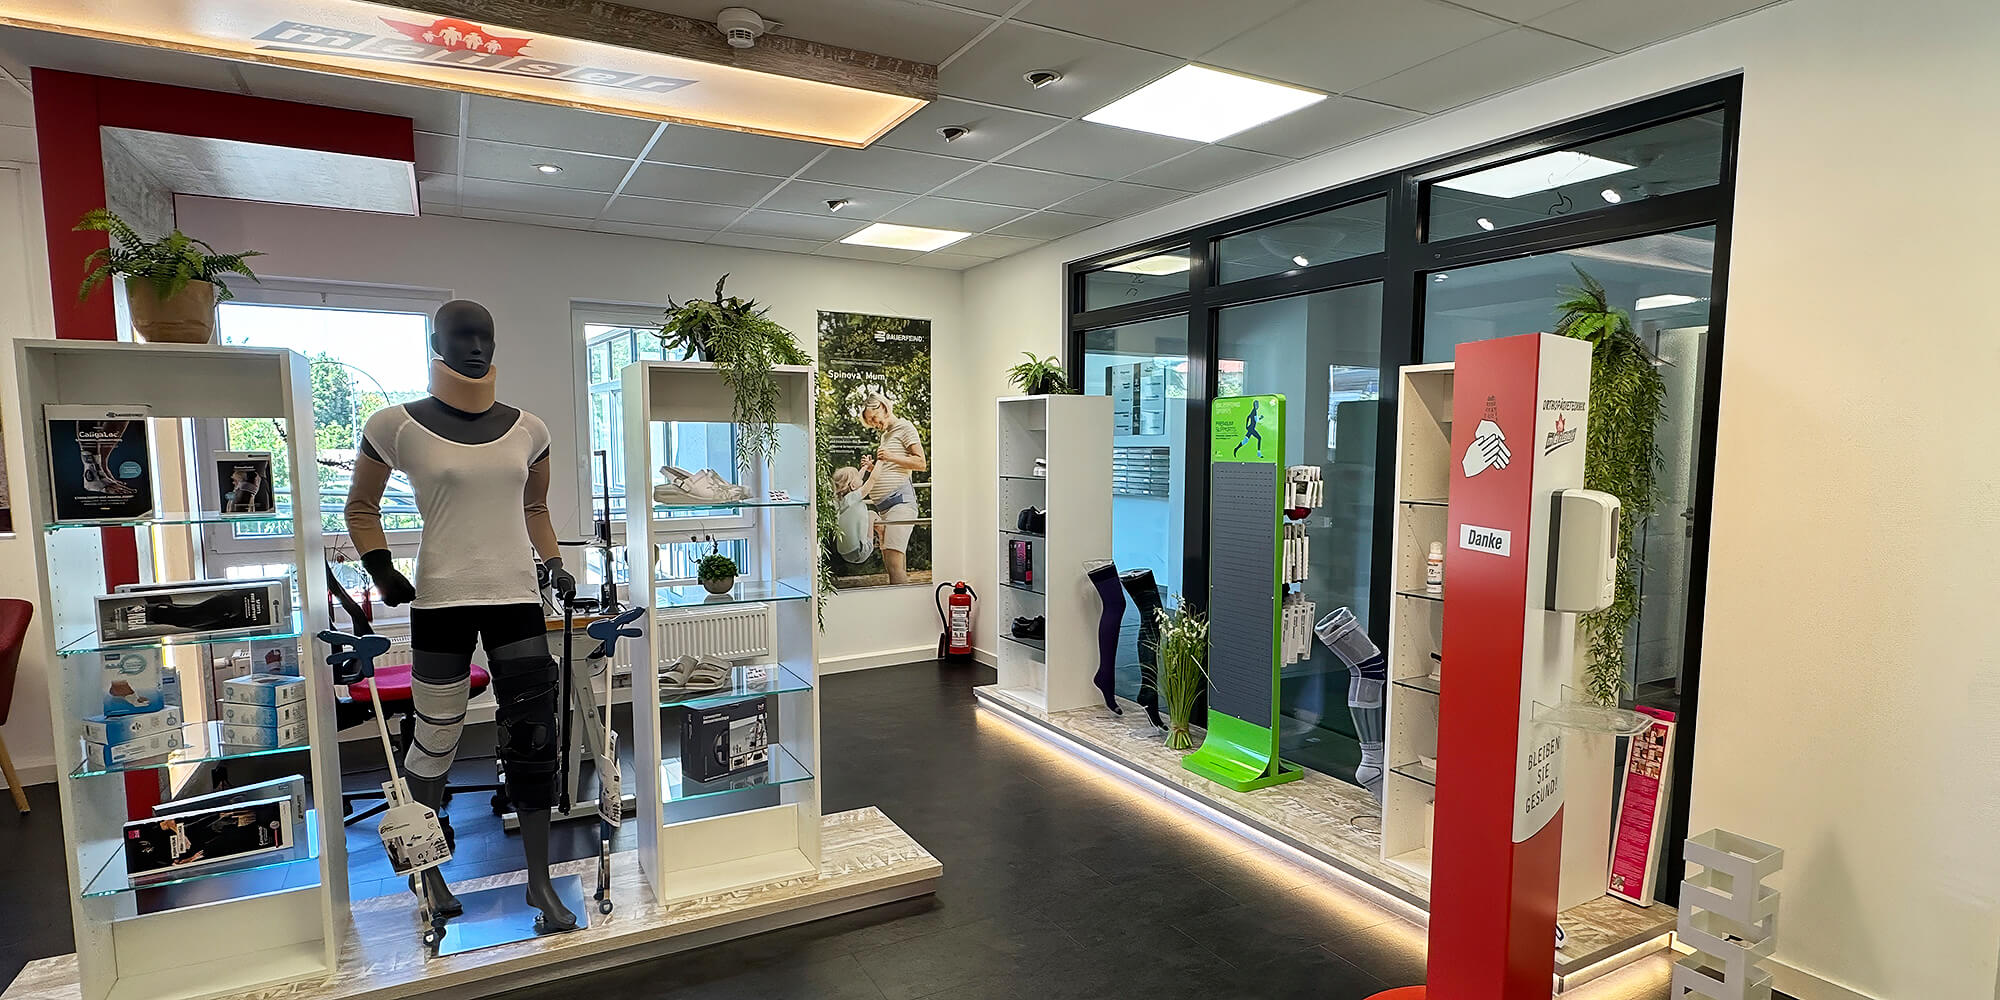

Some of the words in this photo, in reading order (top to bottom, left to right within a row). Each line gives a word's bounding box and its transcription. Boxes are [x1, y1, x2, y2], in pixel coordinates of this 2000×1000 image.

[828, 370, 861, 380] Spinova
[865, 372, 885, 380] Mum
[1468, 529, 1503, 550] Danke
[1528, 736, 1560, 770] BLEIBEN
[1537, 763, 1550, 784] SIE
[1526, 777, 1558, 813] GESUND!
